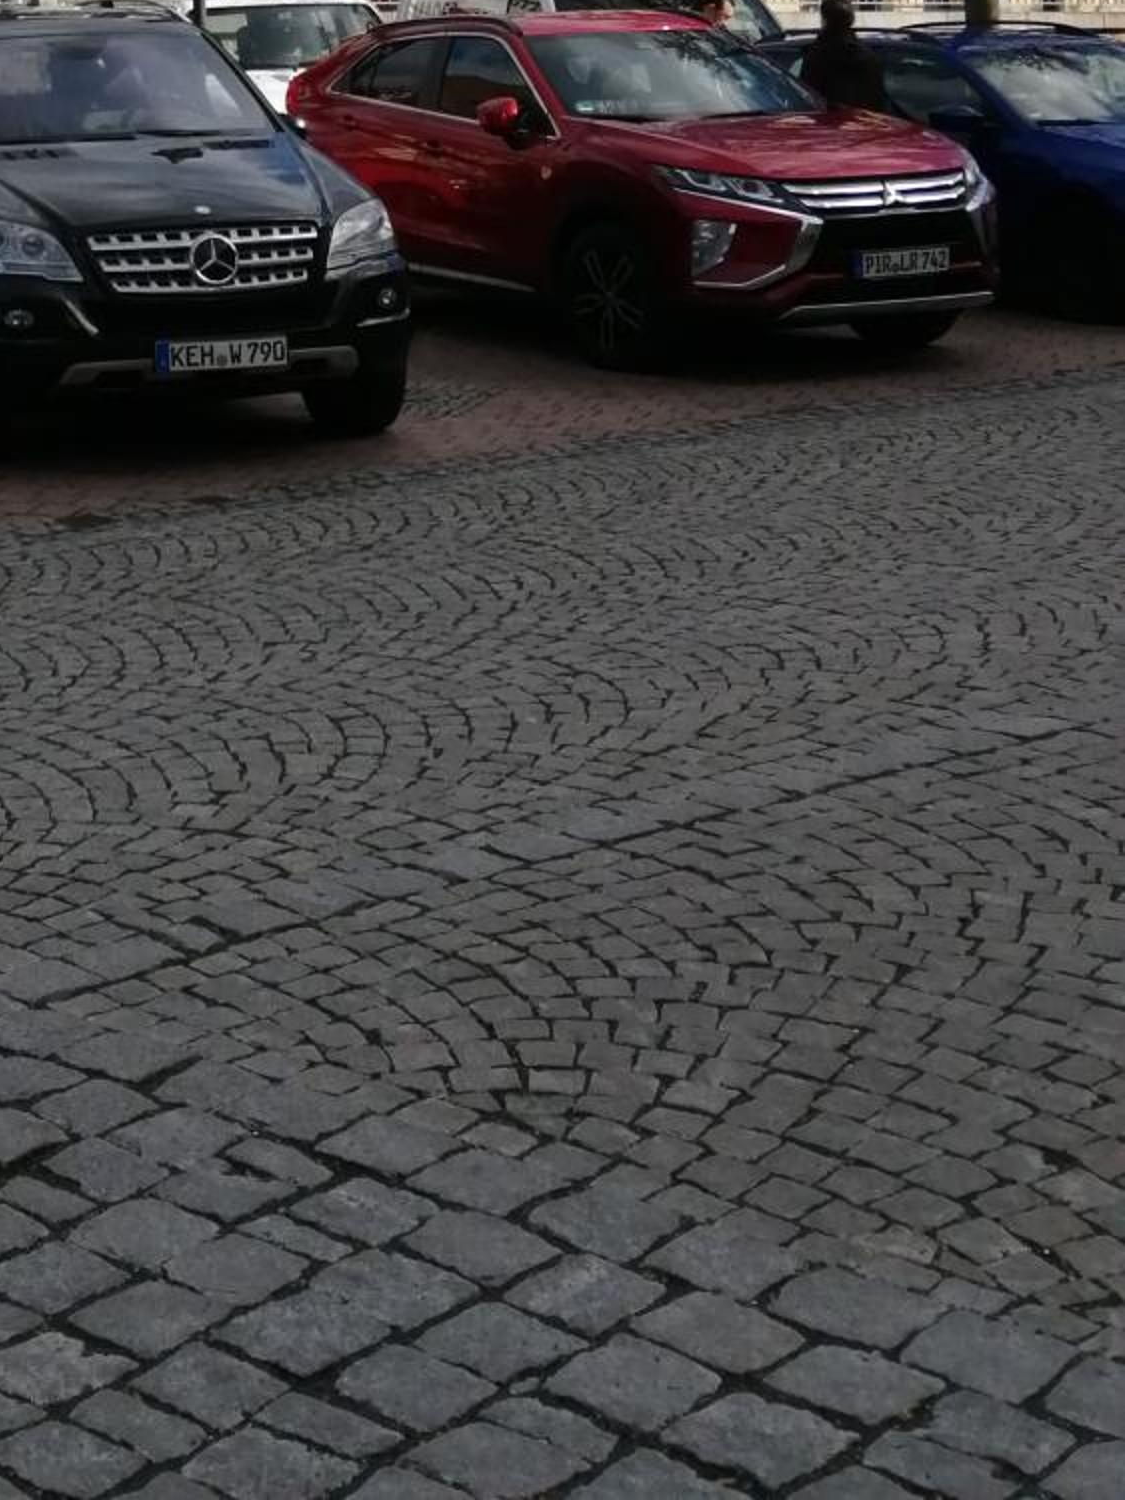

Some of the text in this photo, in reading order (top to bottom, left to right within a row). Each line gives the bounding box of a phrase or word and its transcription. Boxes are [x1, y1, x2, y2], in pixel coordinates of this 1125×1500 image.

[170, 340, 285, 367] KEH W 790
